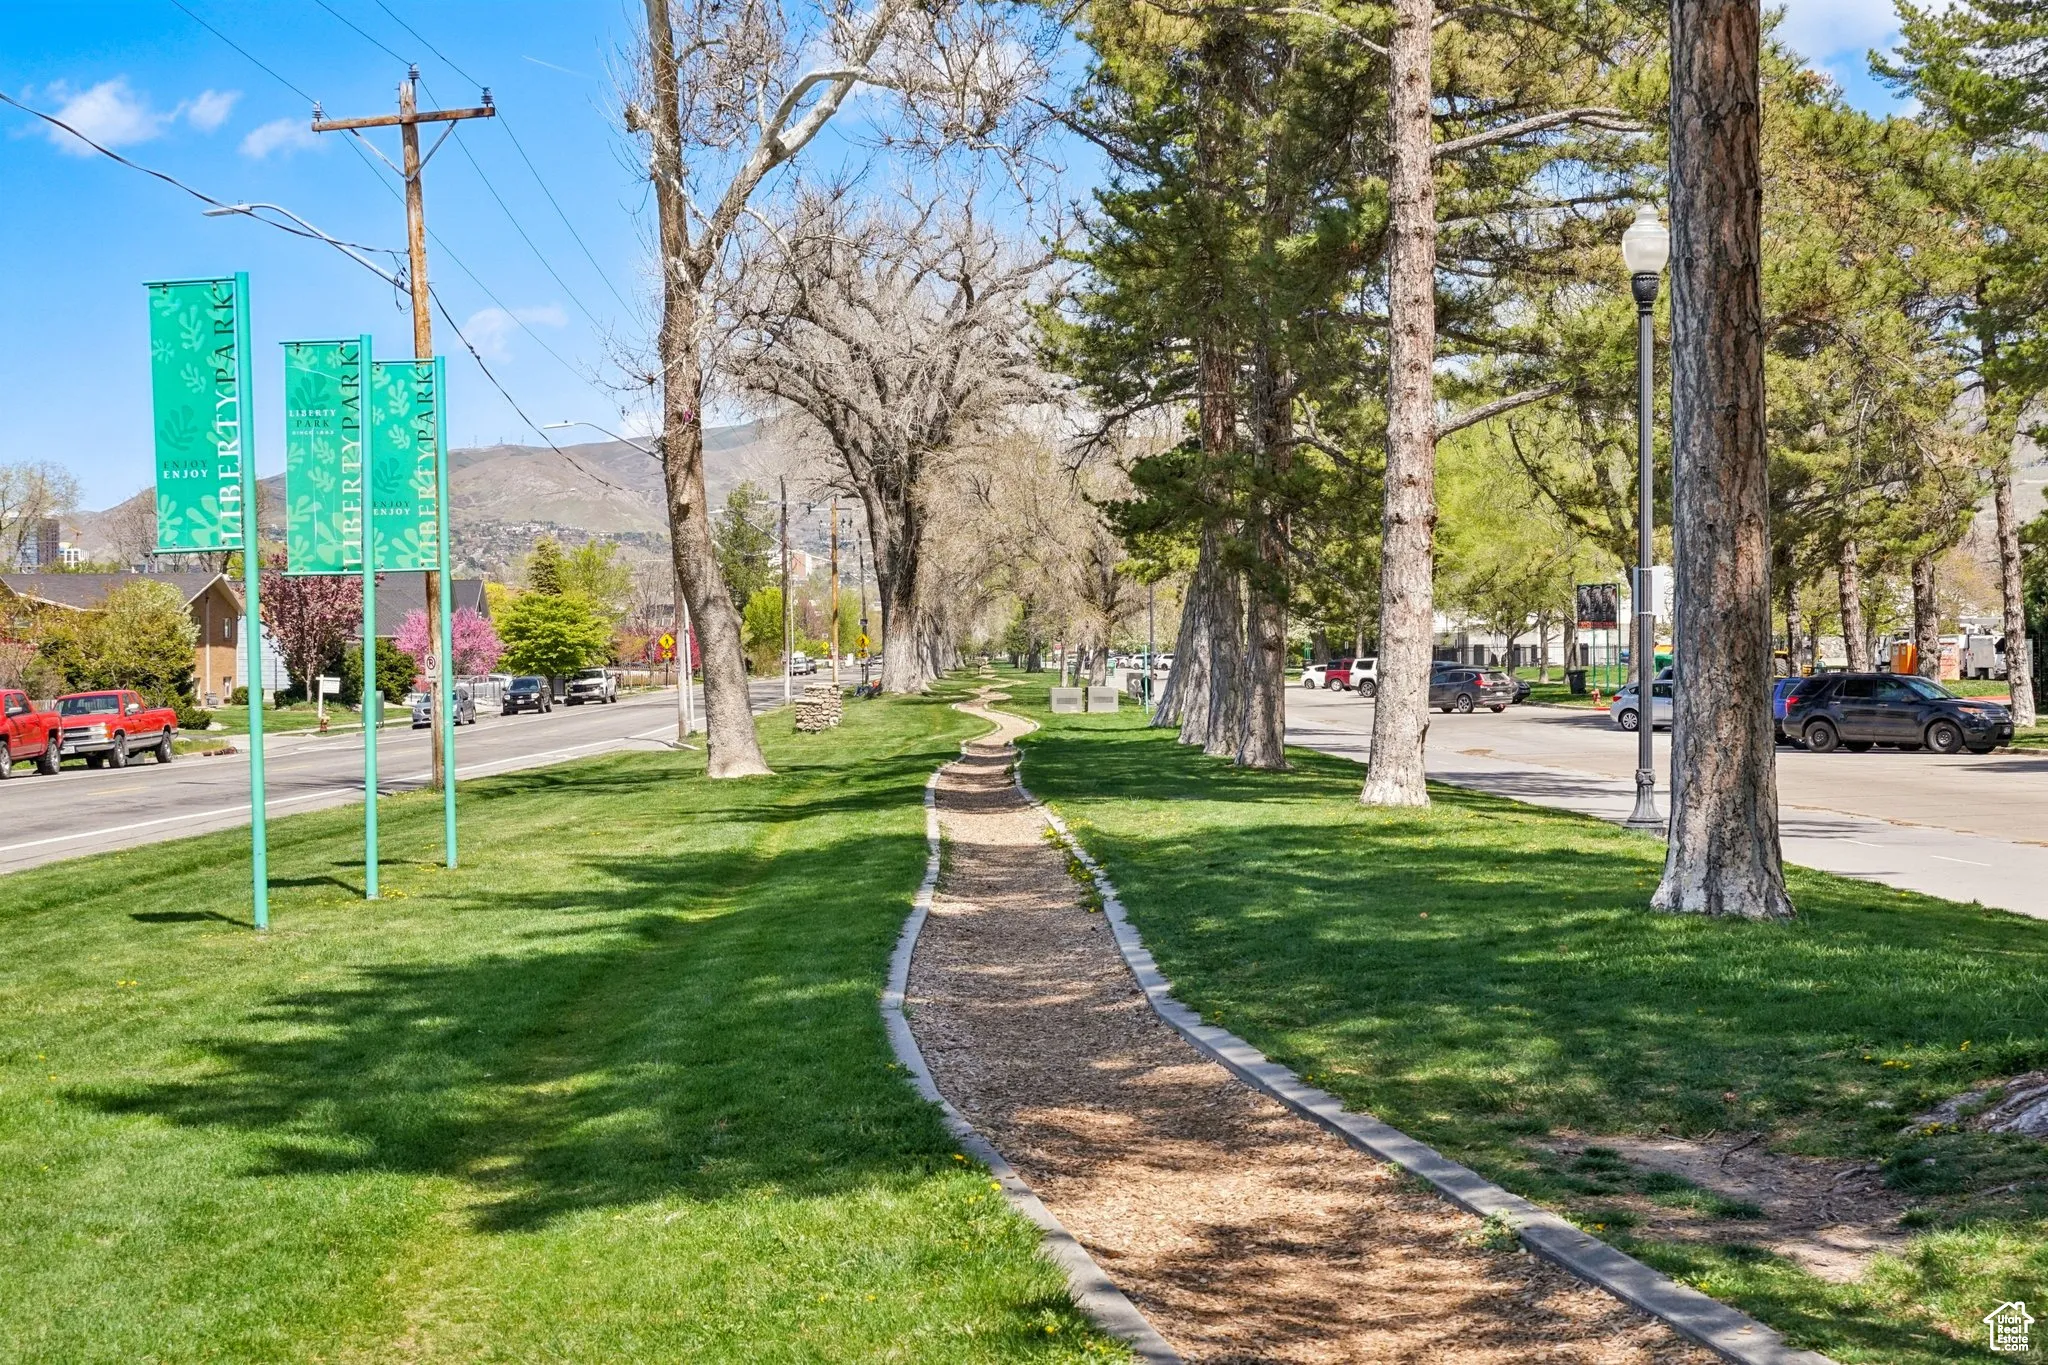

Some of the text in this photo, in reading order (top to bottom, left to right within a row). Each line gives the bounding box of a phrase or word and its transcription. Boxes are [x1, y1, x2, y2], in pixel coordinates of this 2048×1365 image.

[289, 409, 336, 417] LIBERTY
[296, 419, 329, 428] PARK
[163, 460, 207, 469] ENJOY
[163, 469, 208, 479] ENJOY
[373, 500, 410, 508] ENJOY
[373, 508, 410, 516] ENJOY
